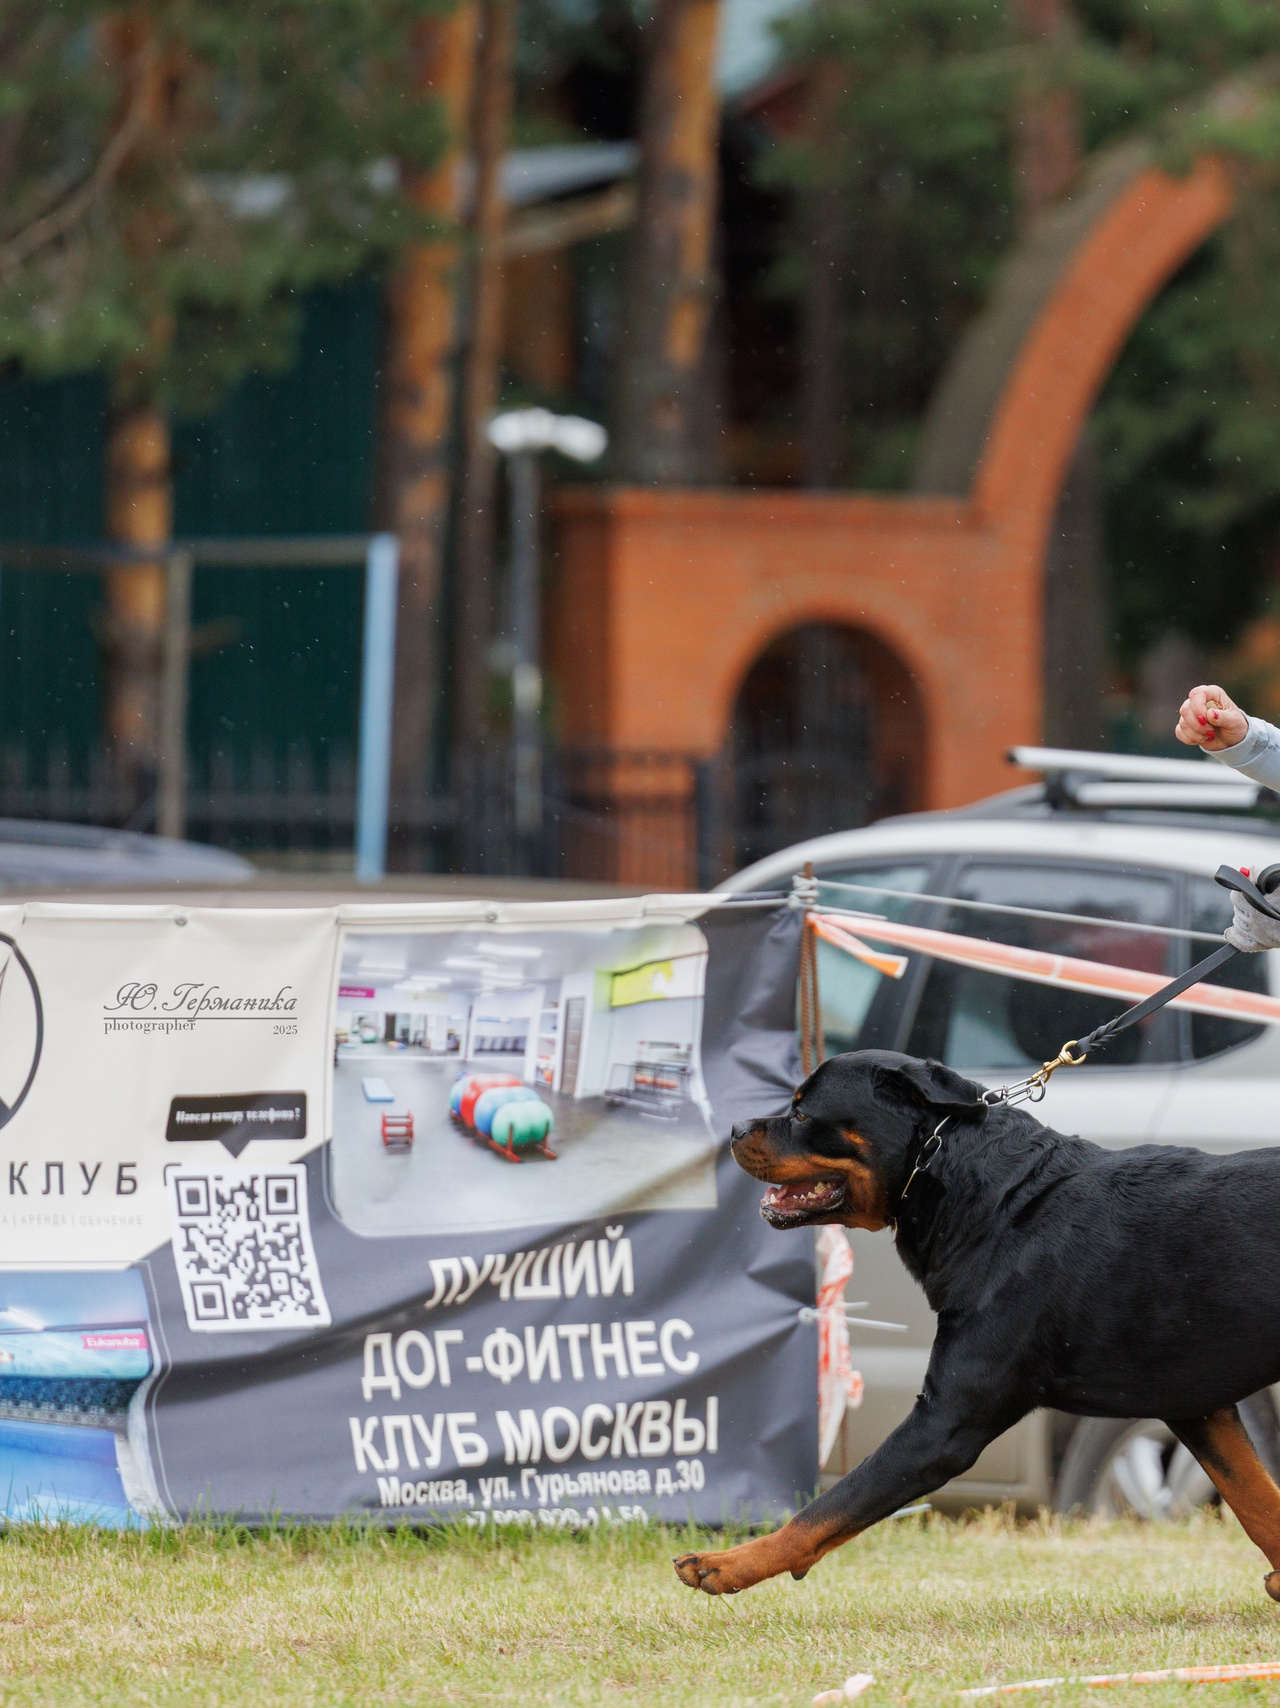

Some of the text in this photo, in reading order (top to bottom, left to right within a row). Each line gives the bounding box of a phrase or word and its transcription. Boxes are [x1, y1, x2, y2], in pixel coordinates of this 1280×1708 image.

[9, 1160, 138, 1196] КЛУБ
[424, 1225, 635, 1310] ЛУЧШИЙ
[361, 1318, 700, 1401] ДОГ-ФИТНЕС
[348, 1396, 719, 1474] КЛУБ МОСКВЫ
[377, 1458, 706, 1510] Москва, ул. Гурьянова д.30
